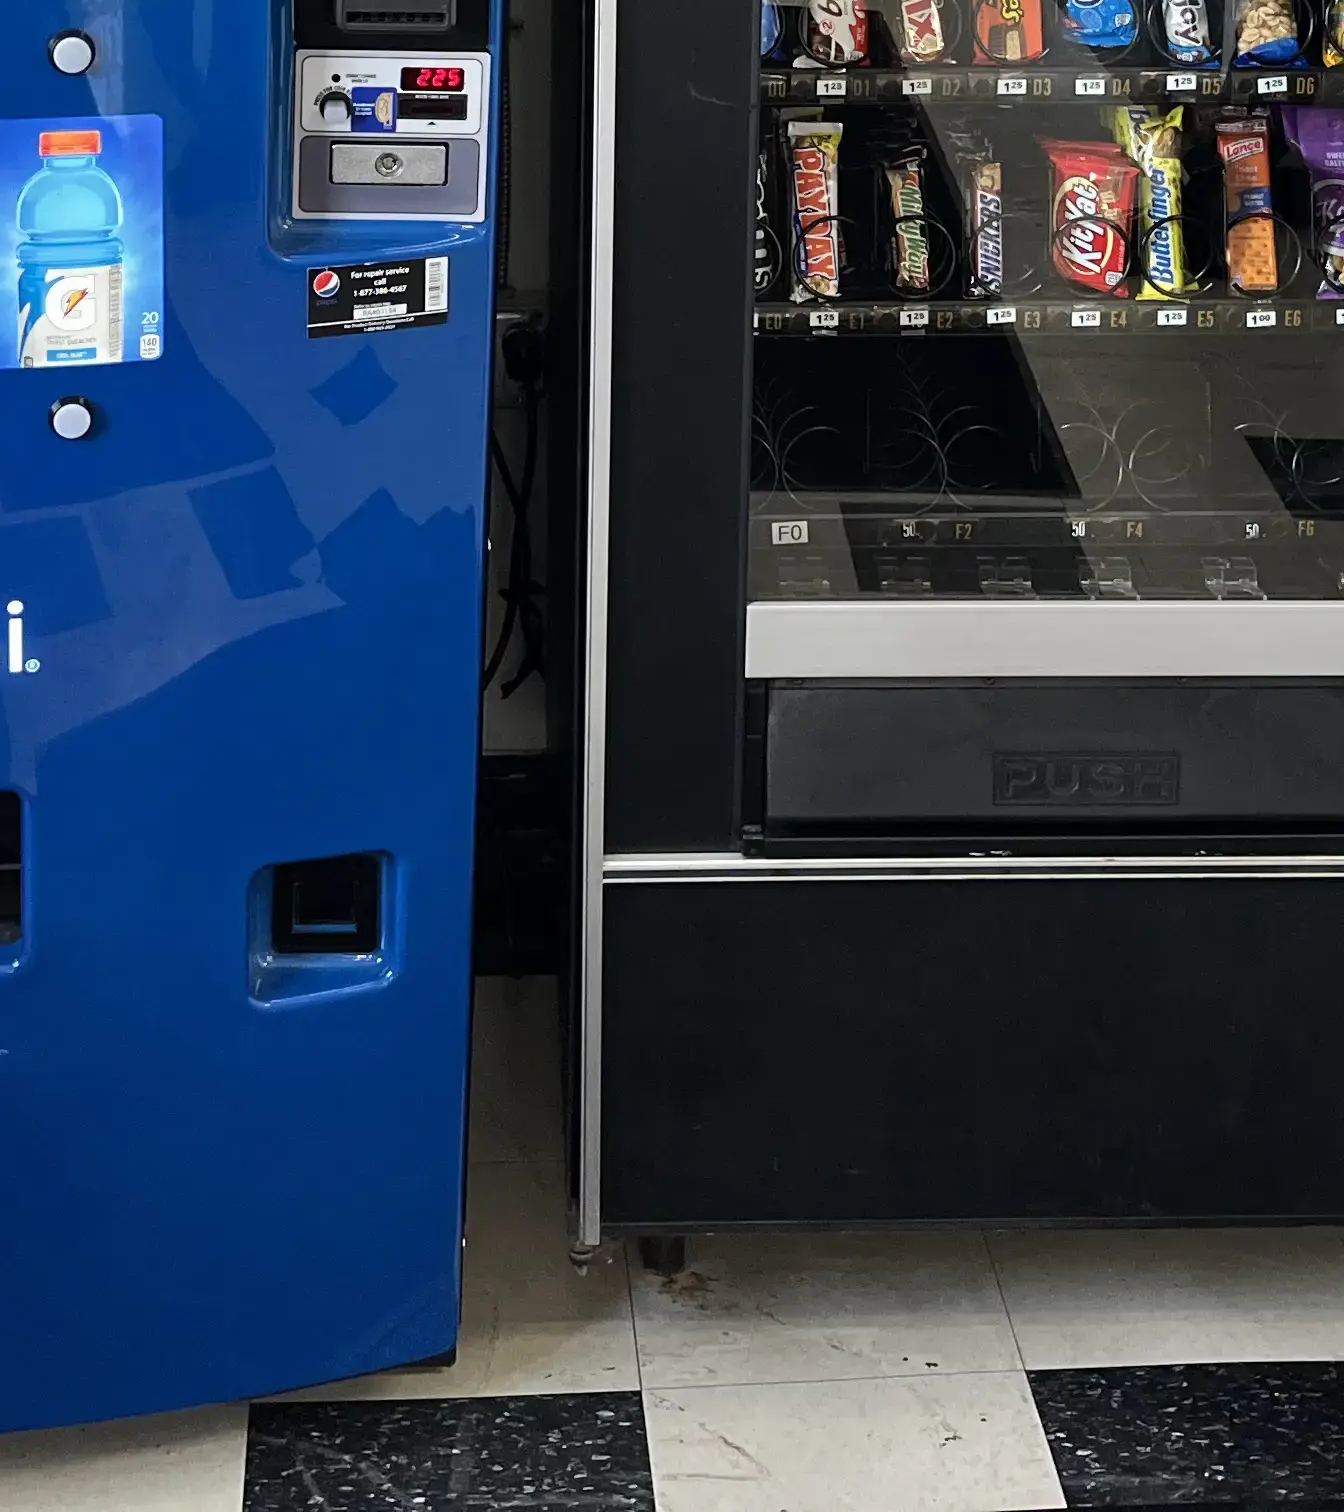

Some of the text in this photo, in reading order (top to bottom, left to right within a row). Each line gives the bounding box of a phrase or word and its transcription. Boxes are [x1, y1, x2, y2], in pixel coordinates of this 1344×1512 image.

[416, 68, 461, 87] 225
[942, 80, 961, 96] D2
[1033, 79, 1052, 96] D3
[1112, 78, 1131, 95] D4
[1202, 78, 1221, 95] D5
[1296, 77, 1315, 95] D6
[1226, 140, 1261, 158] Lance
[793, 147, 837, 280] PAYDAY
[1150, 168, 1175, 285] Butterfinger
[979, 192, 1001, 286] SNICKERS
[350, 266, 410, 280] For repair service
[373, 277, 387, 286] call
[45, 274, 97, 331] G
[141, 311, 159, 325] 20
[937, 312, 954, 329] E2
[1023, 311, 1040, 329] E3
[1110, 311, 1127, 328] E4
[1197, 311, 1214, 328] E5
[1284, 310, 1301, 327] E6
[142, 337, 157, 347] 140
[777, 524, 803, 541] F0
[955, 523, 972, 539] F2
[1071, 521, 1086, 537] 50
[1126, 521, 1143, 538] F4
[1245, 523, 1260, 539] 50
[1298, 520, 1314, 537] F6
[1006, 761, 1170, 799] PUSH
